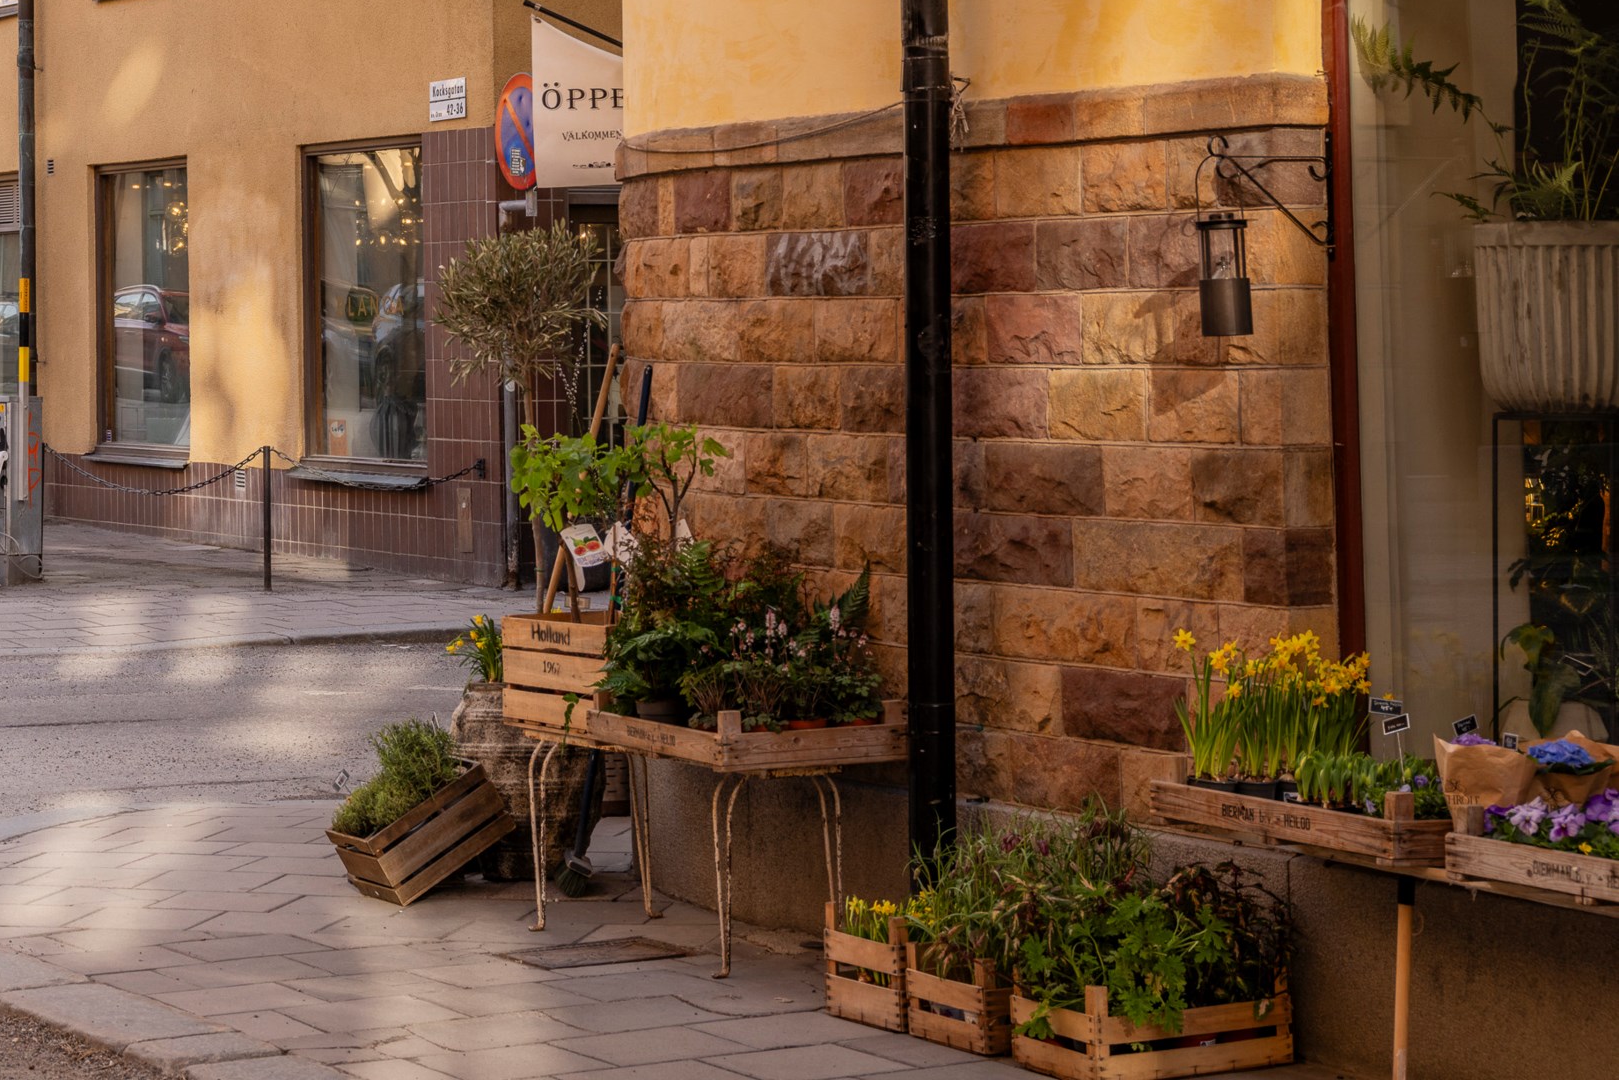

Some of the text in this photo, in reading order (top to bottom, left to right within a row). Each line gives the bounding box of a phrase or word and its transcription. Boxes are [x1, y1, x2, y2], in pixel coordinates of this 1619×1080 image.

[432, 84, 464, 99] Kocksgatan
[446, 102, 464, 116] 42-36
[531, 622, 571, 646] Holland
